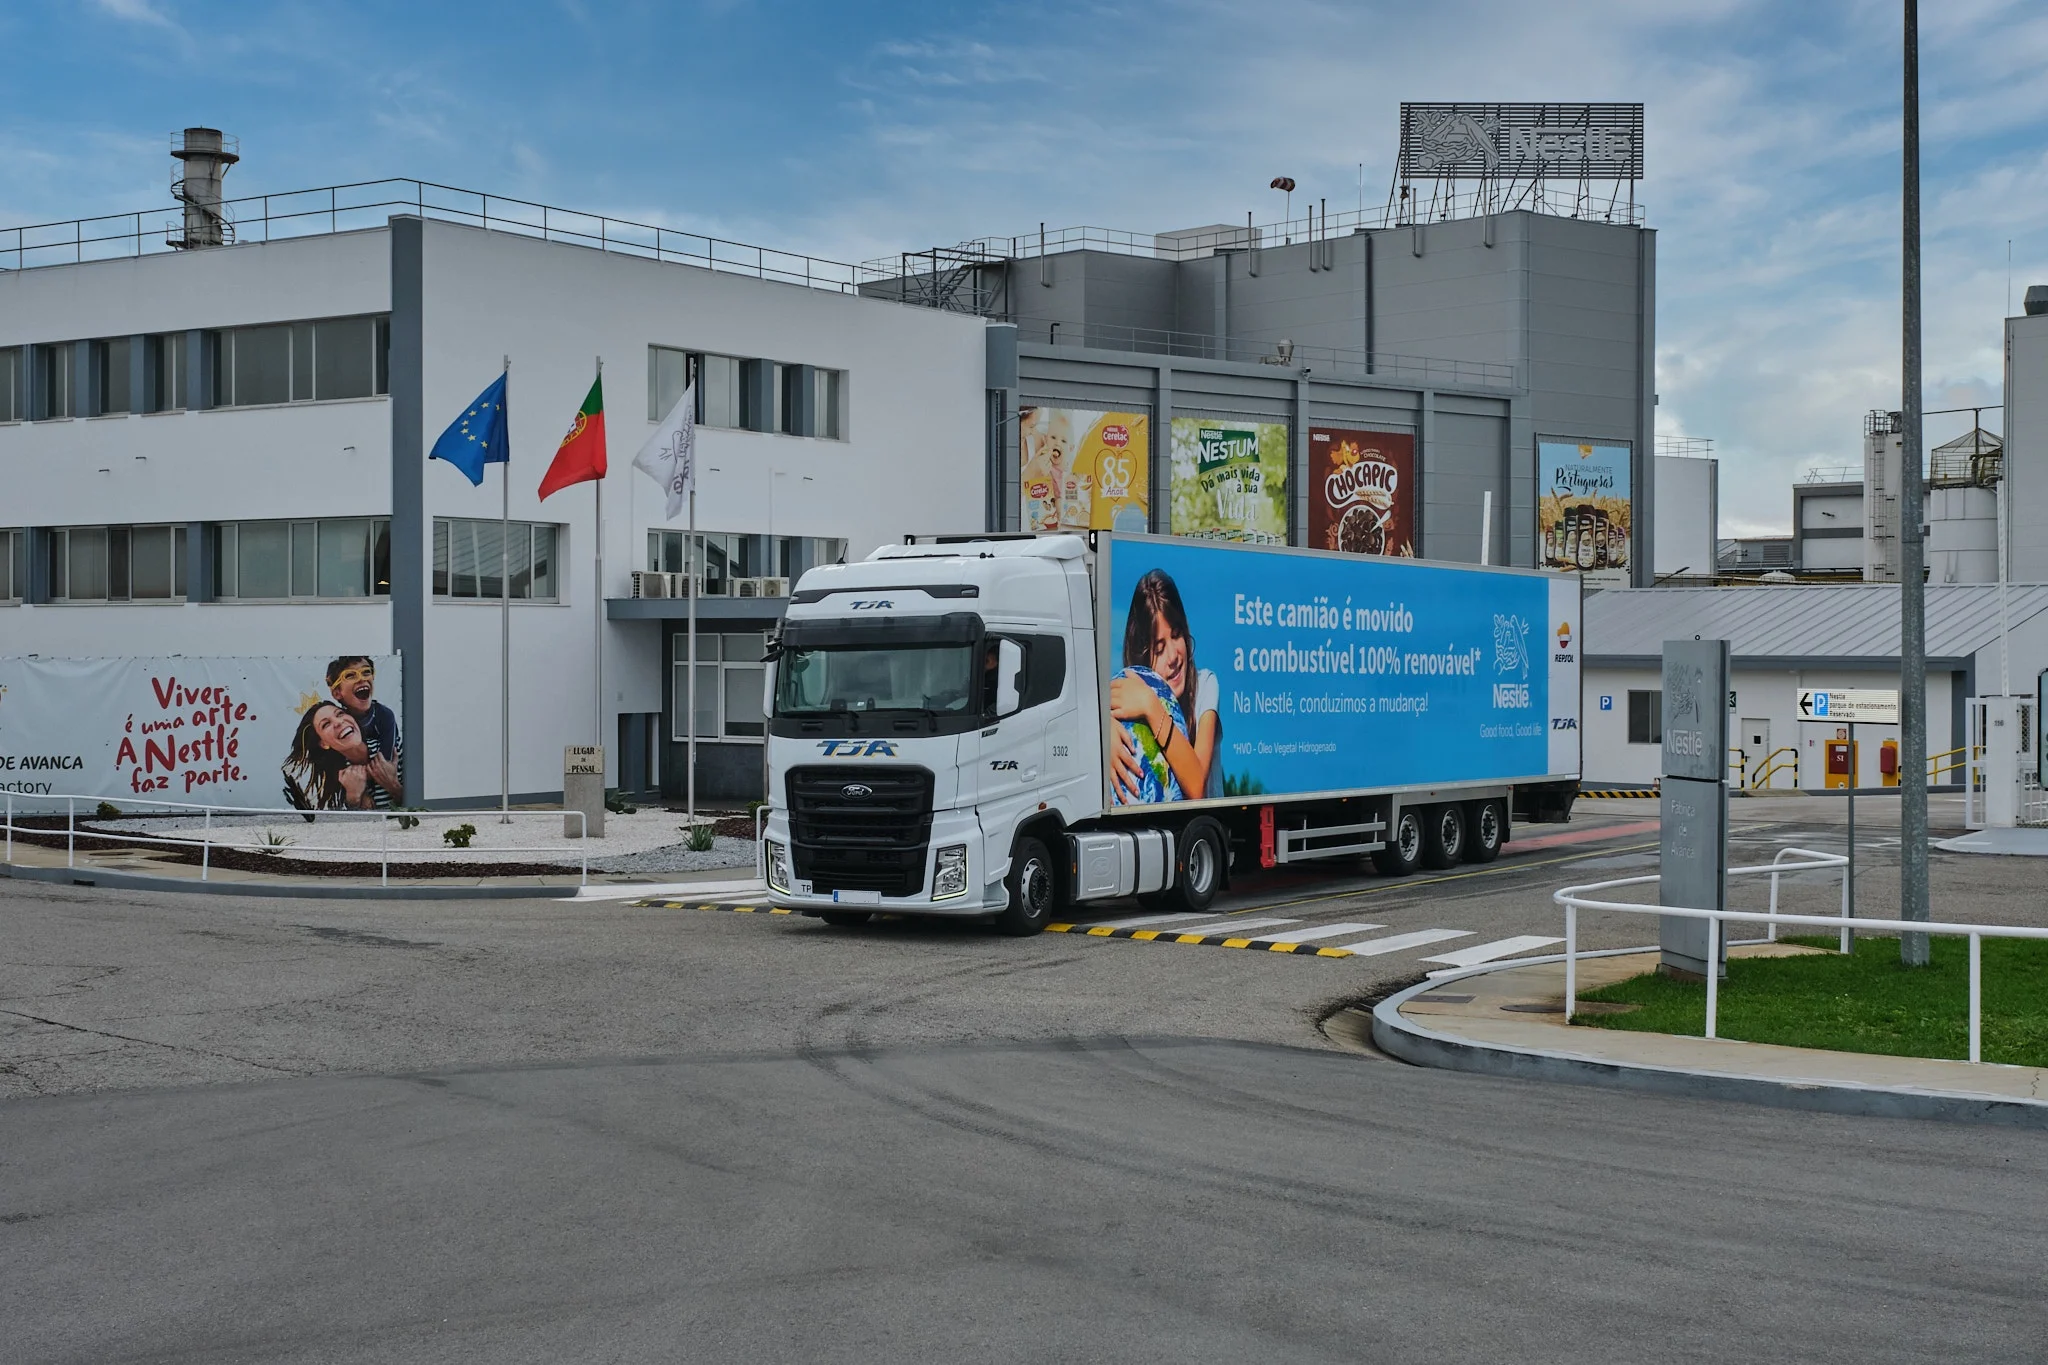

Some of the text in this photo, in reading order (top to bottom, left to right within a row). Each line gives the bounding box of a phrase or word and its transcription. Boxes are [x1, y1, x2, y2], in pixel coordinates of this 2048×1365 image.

[1509, 127, 1632, 161] Nestlé
[1103, 431, 1127, 441] Cerelac
[1197, 437, 1259, 464] NESTUM
[1102, 456, 1129, 488] 85
[1201, 466, 1260, 493] Dá mais vida
[1555, 467, 1613, 495] Portuguesas
[1106, 487, 1124, 495] Anos
[1237, 479, 1258, 493] à sua
[1327, 463, 1395, 506] CHOCAPIC
[1216, 488, 1259, 520] Vida
[850, 600, 895, 610] TJA
[1234, 594, 1414, 633] Este camião é movido
[1233, 646, 1245, 672] a
[1249, 639, 1355, 675] combustível
[1358, 646, 1401, 675] 100%
[1555, 654, 1574, 663] REPSOL
[151, 677, 225, 709] Viver
[1492, 683, 1530, 709] Nestlé
[1233, 691, 1429, 718] Na Nestlé, conduzimos a mudança!
[1602, 697, 1610, 710] P
[1816, 694, 1826, 714] P
[125, 695, 257, 735] é uma arte.
[1551, 718, 1578, 730] TJA
[1480, 723, 1498, 738] Good
[1515, 722, 1532, 737] Good
[116, 723, 239, 774] A Nestlé
[573, 746, 595, 755] LUGAR
[816, 740, 899, 758] TJA
[1052, 745, 1069, 757] 3302
[1257, 740, 1273, 754] Óleo
[1274, 743, 1297, 756] Vegetal
[1298, 742, 1337, 755] Hidrogenado
[1666, 729, 1703, 757] Nestlé
[19, 755, 84, 770] AVANCA
[990, 760, 1018, 771] TJA
[130, 757, 248, 794] faz parte.
[846, 786, 865, 796] Ford
[801, 884, 812, 893] TP
